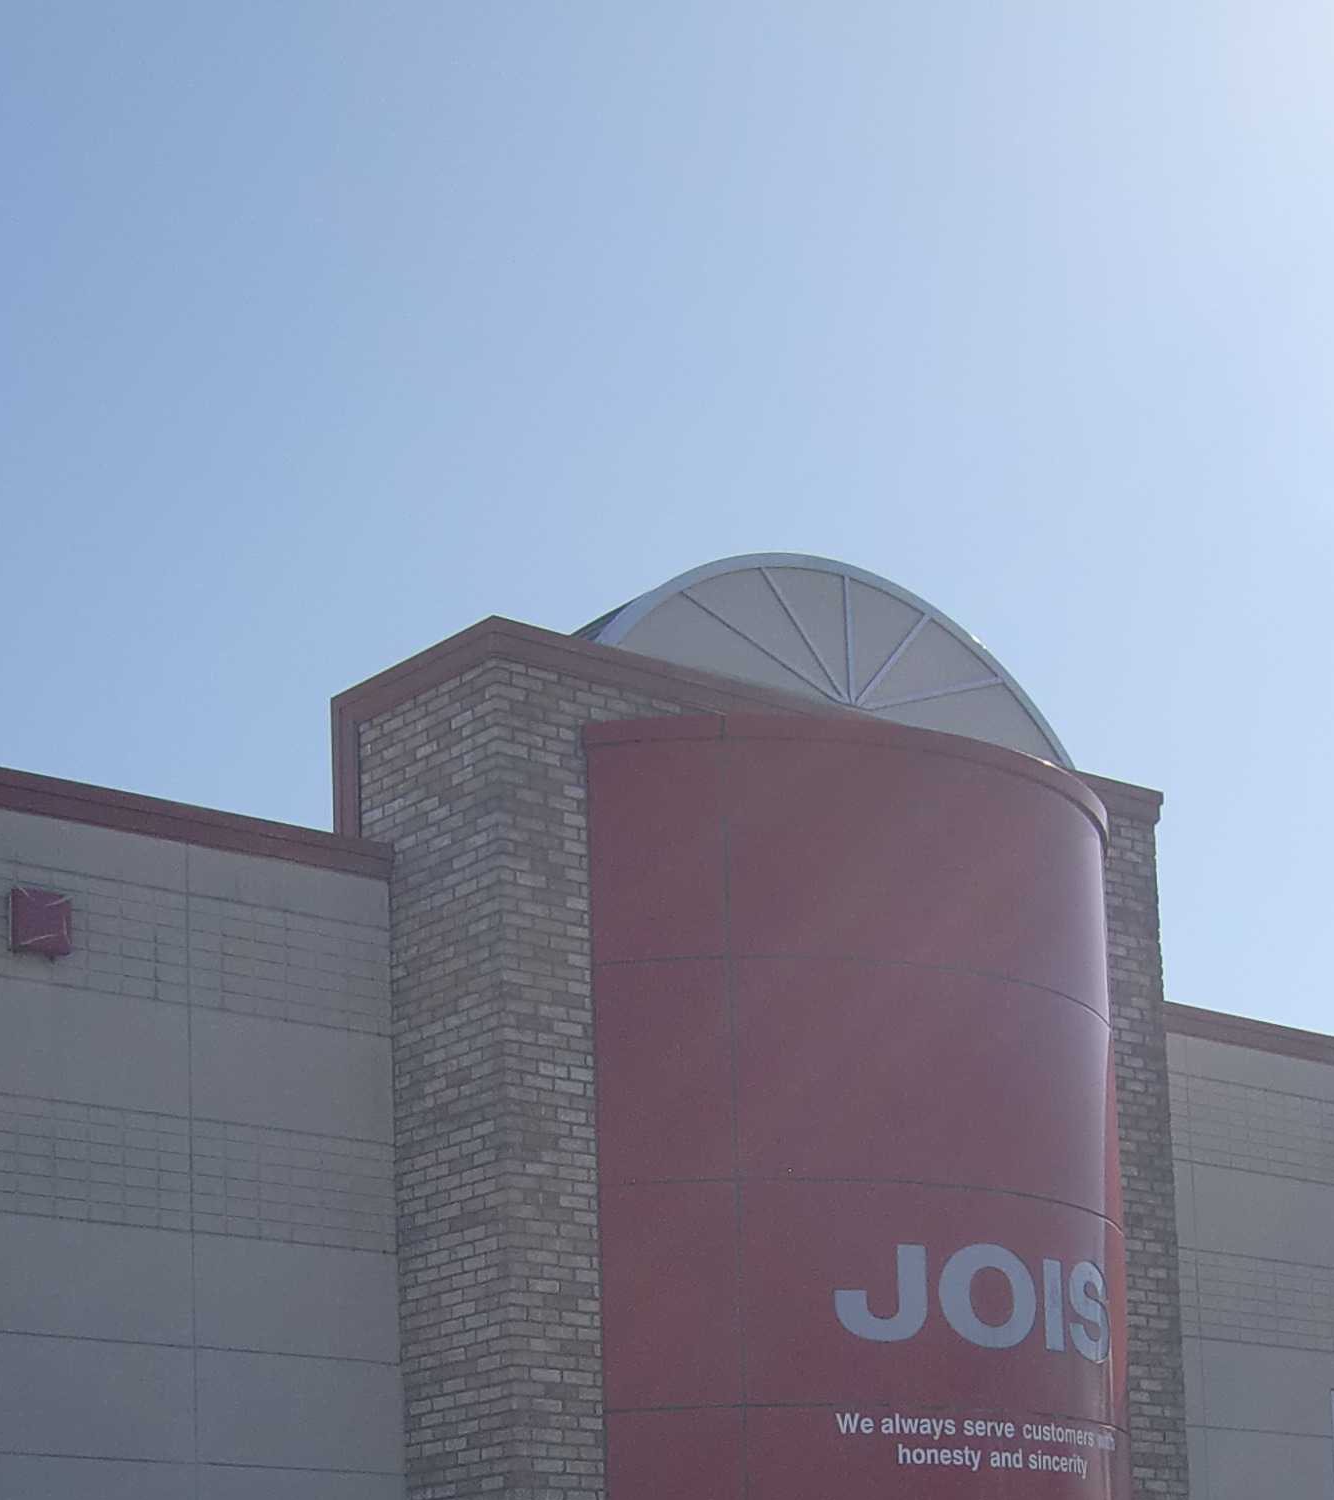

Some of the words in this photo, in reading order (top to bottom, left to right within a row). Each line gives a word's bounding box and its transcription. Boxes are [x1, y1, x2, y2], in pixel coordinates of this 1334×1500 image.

[833, 1243, 1110, 1364] JOIS
[835, 1413, 875, 1434] We
[880, 1413, 956, 1440] always
[963, 1419, 1015, 1437] serve
[1022, 1423, 1095, 1448] customers
[1097, 1431, 1116, 1451] with
[897, 1444, 982, 1471] honesty
[990, 1449, 1023, 1469] and
[1028, 1450, 1088, 1479] sincerity
